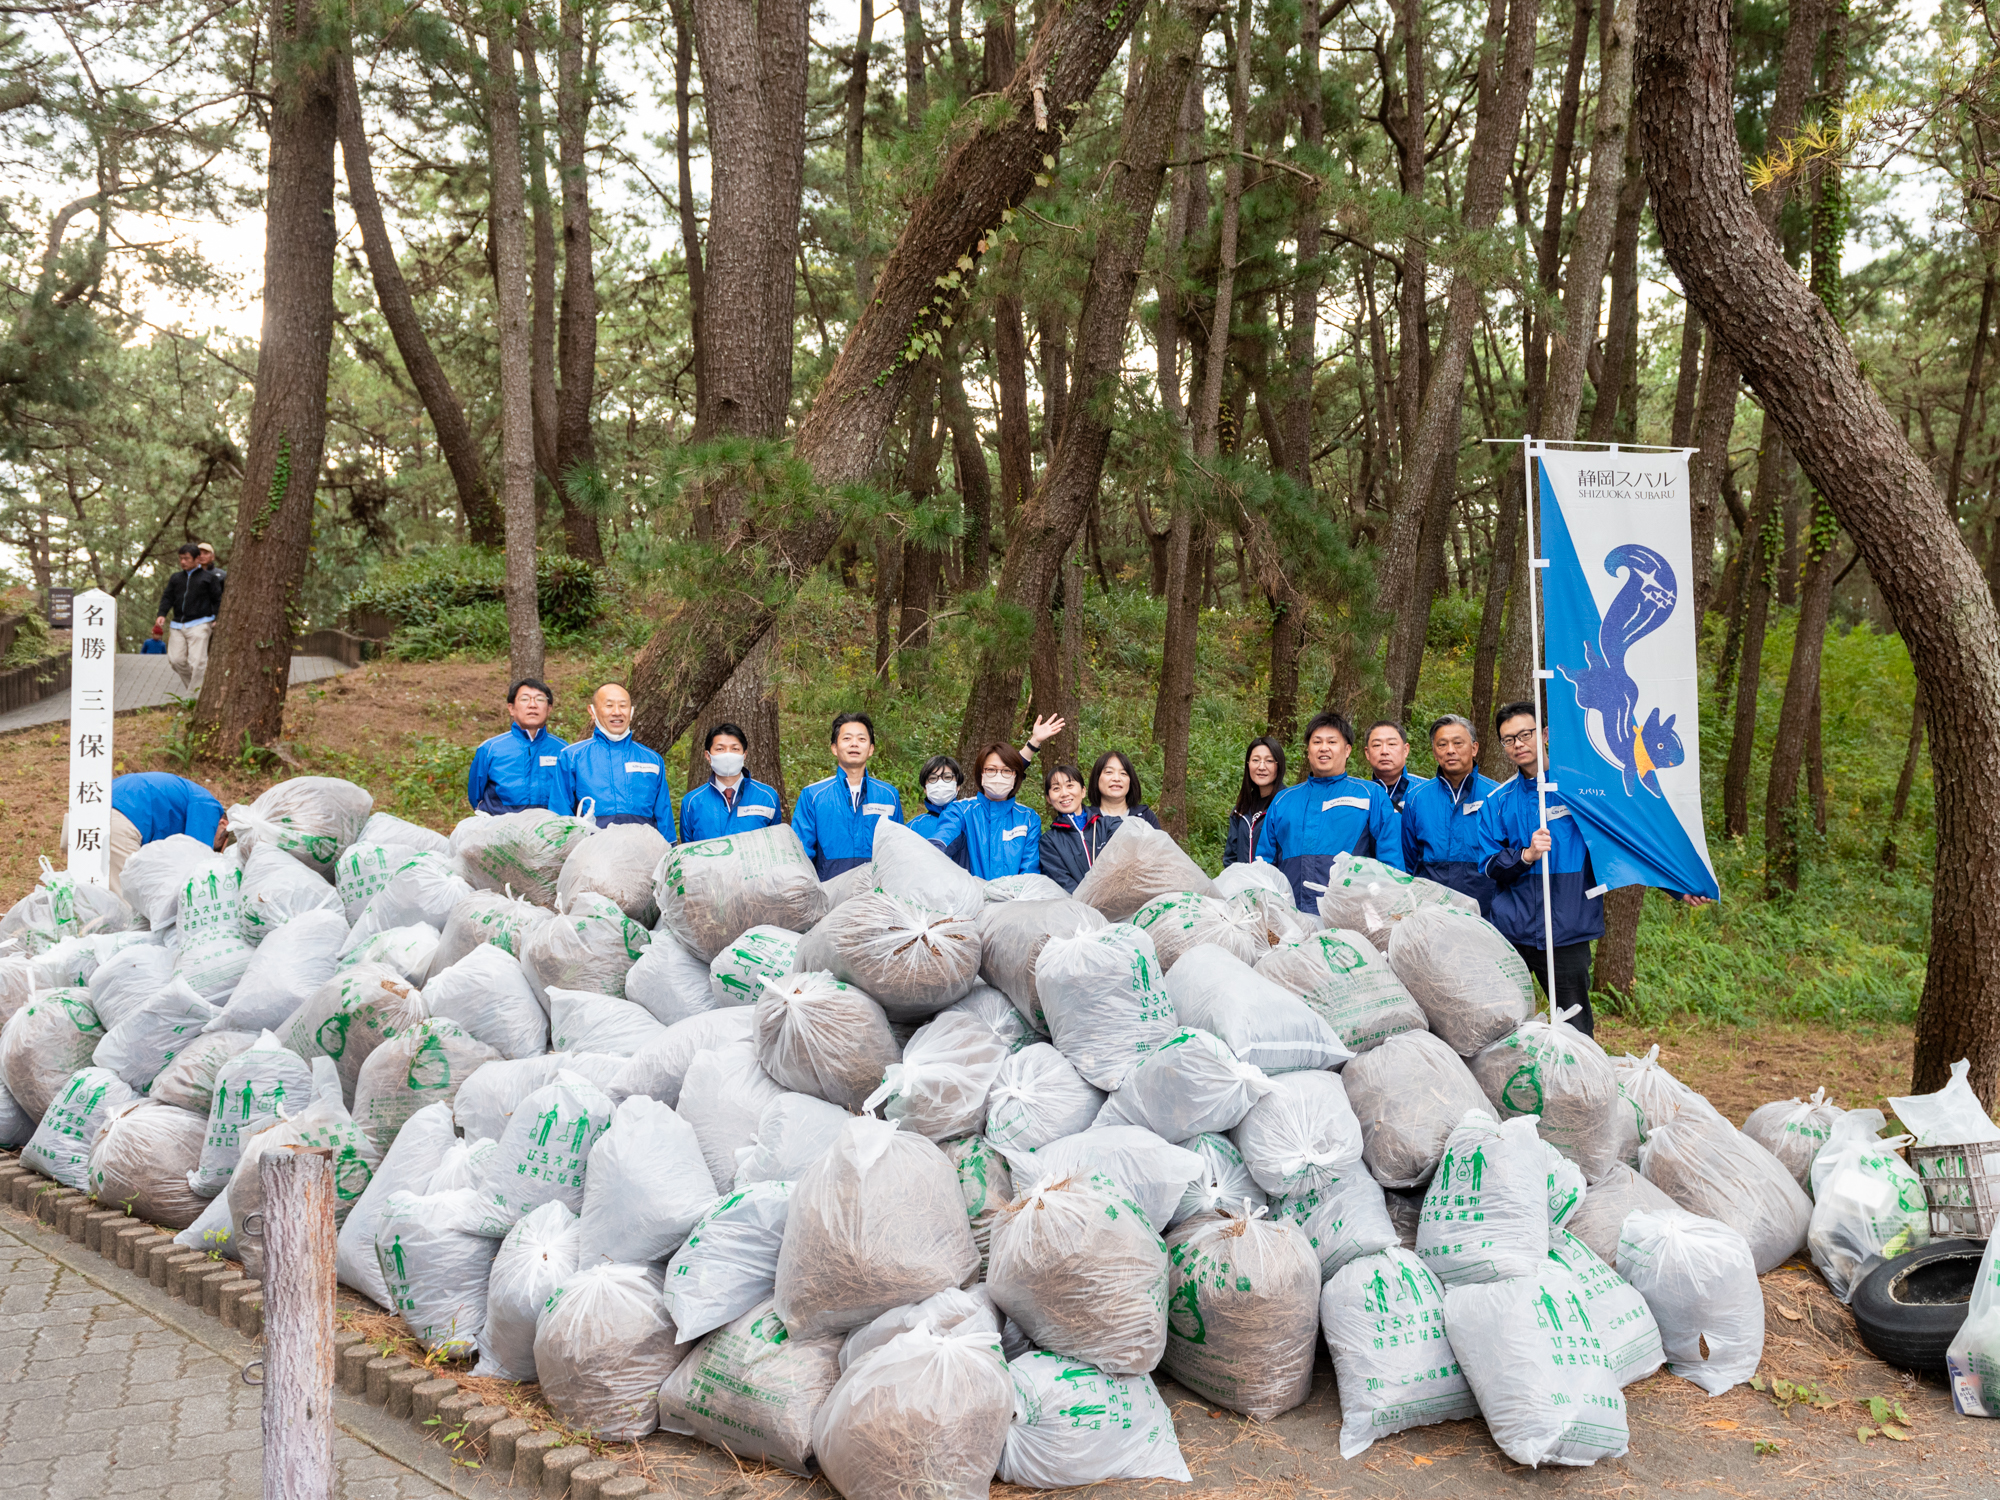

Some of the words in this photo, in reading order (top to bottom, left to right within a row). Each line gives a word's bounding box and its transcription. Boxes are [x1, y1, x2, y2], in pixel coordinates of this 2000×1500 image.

[1578, 470, 1677, 488] 静岡スバル
[1578, 489, 1631, 499] SHIZUOKA
[1634, 490, 1675, 500] SUBARU
[80, 604, 106, 660] 名勝
[75, 689, 105, 851] 三保松原
[527, 1149, 588, 1173] ひろえば
[1401, 1363, 1460, 1385] ごみ収集袋
